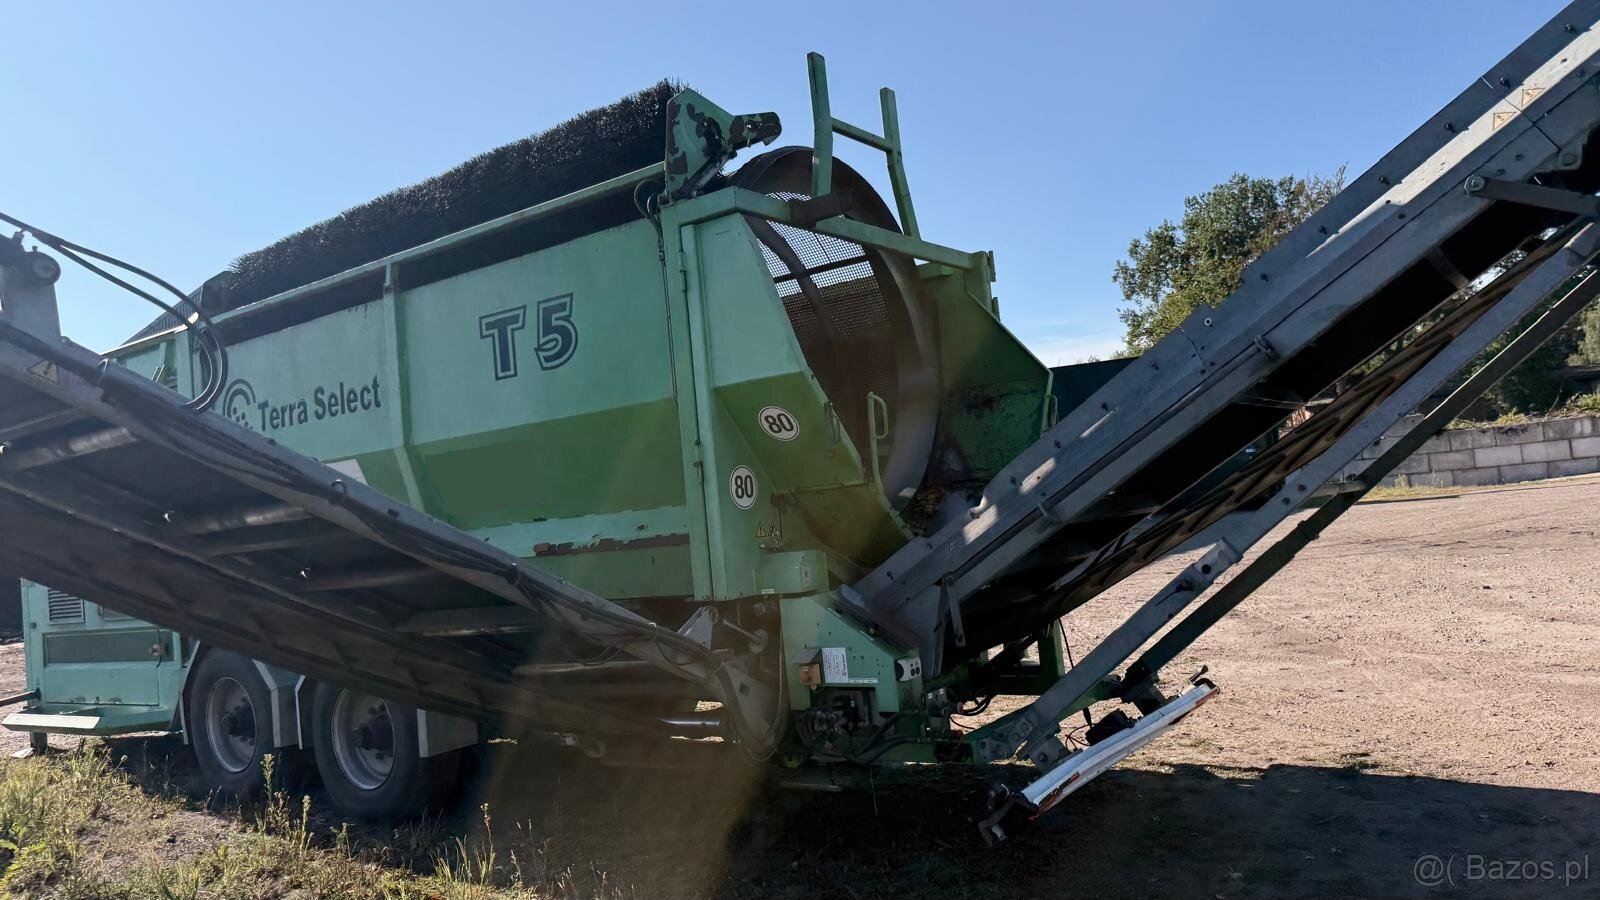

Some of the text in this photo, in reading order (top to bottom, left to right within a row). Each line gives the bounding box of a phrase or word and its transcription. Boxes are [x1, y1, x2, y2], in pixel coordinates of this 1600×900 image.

[258, 374, 381, 431] Terra Select
[764, 413, 794, 434] 80
[735, 474, 754, 499] 80
